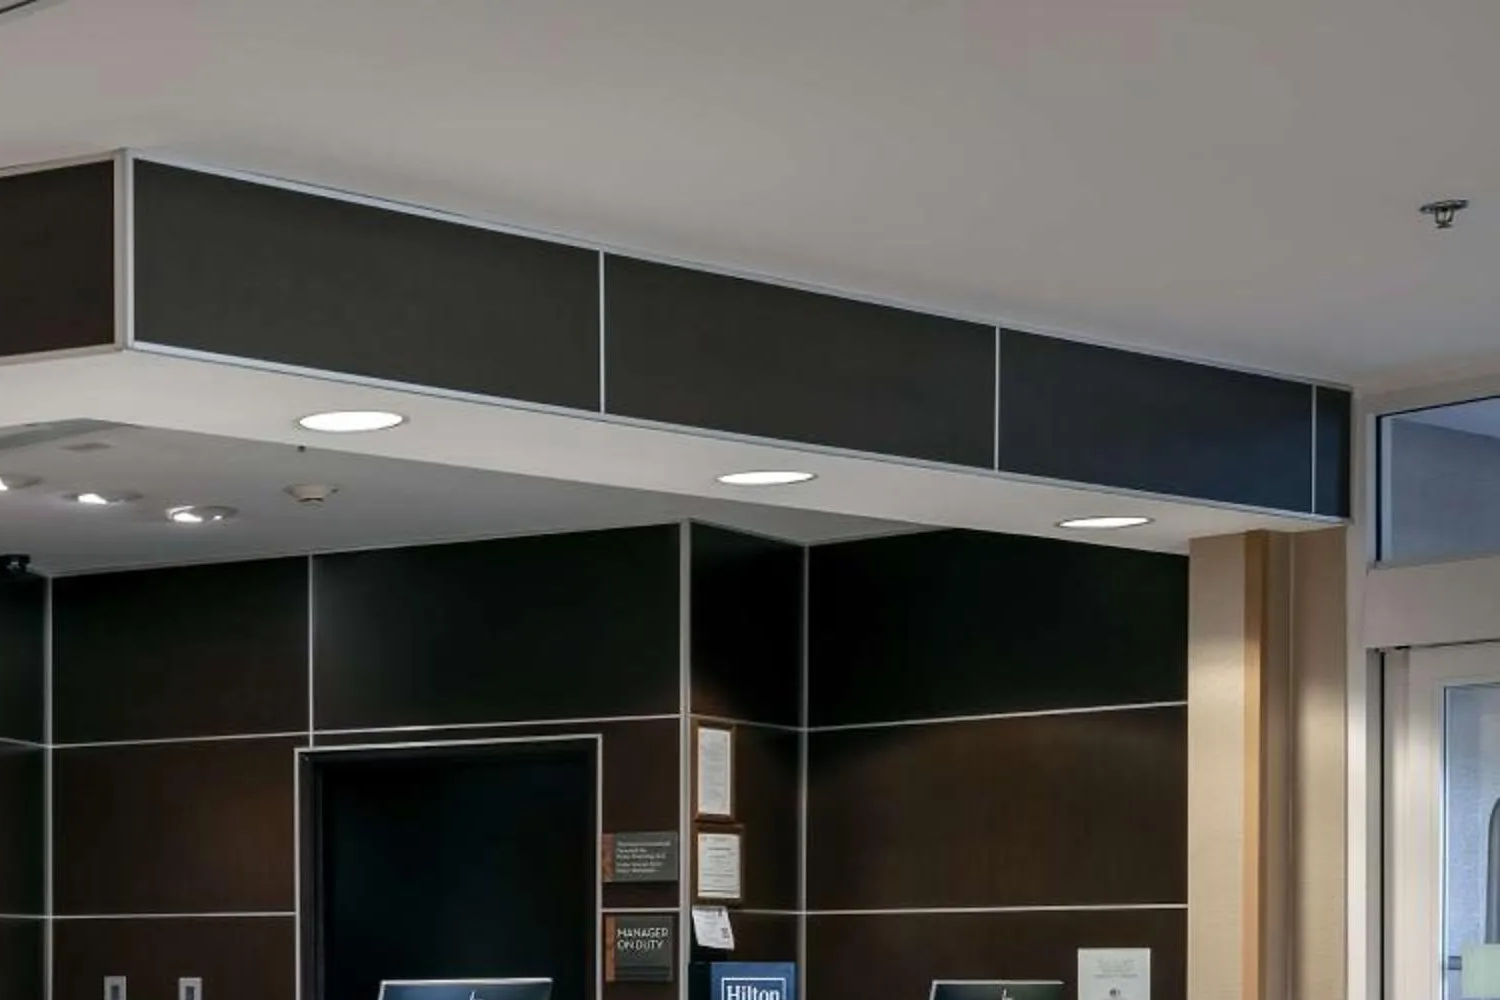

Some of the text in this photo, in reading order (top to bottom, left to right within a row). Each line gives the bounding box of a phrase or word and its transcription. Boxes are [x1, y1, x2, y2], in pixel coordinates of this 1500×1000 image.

[617, 927, 669, 937] MANAGER
[617, 939, 665, 950] ON DUTY
